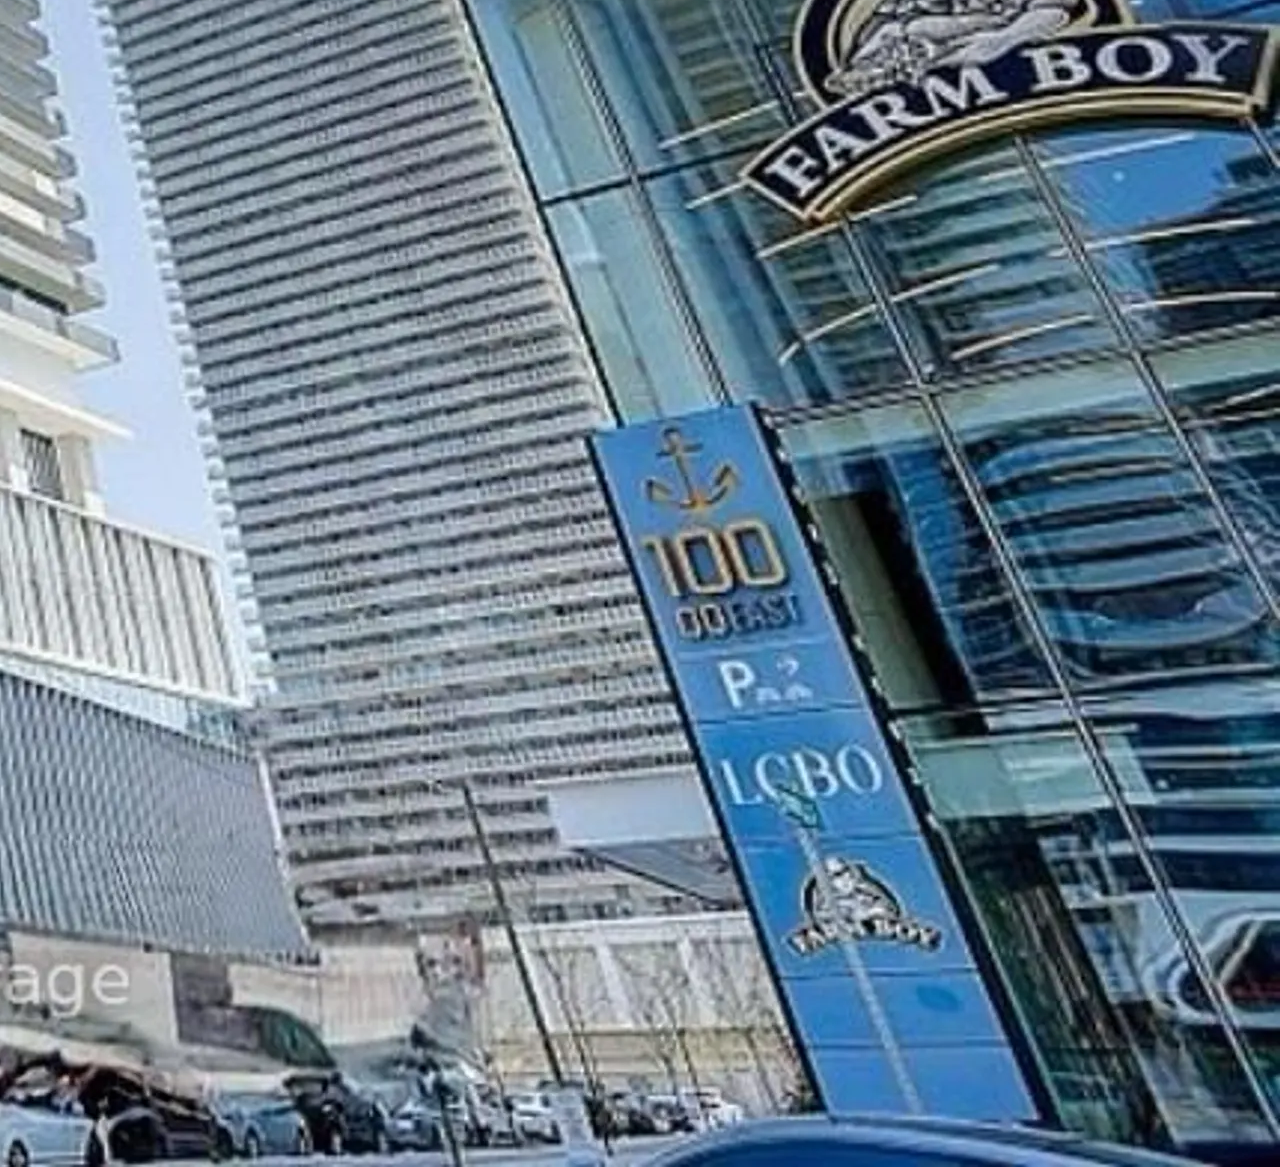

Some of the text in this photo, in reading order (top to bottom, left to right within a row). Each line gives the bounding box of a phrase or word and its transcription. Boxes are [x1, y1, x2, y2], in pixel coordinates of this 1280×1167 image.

[763, 33, 1250, 199] FARM BOY
[642, 515, 787, 599] 100
[720, 743, 884, 807] LCBO
